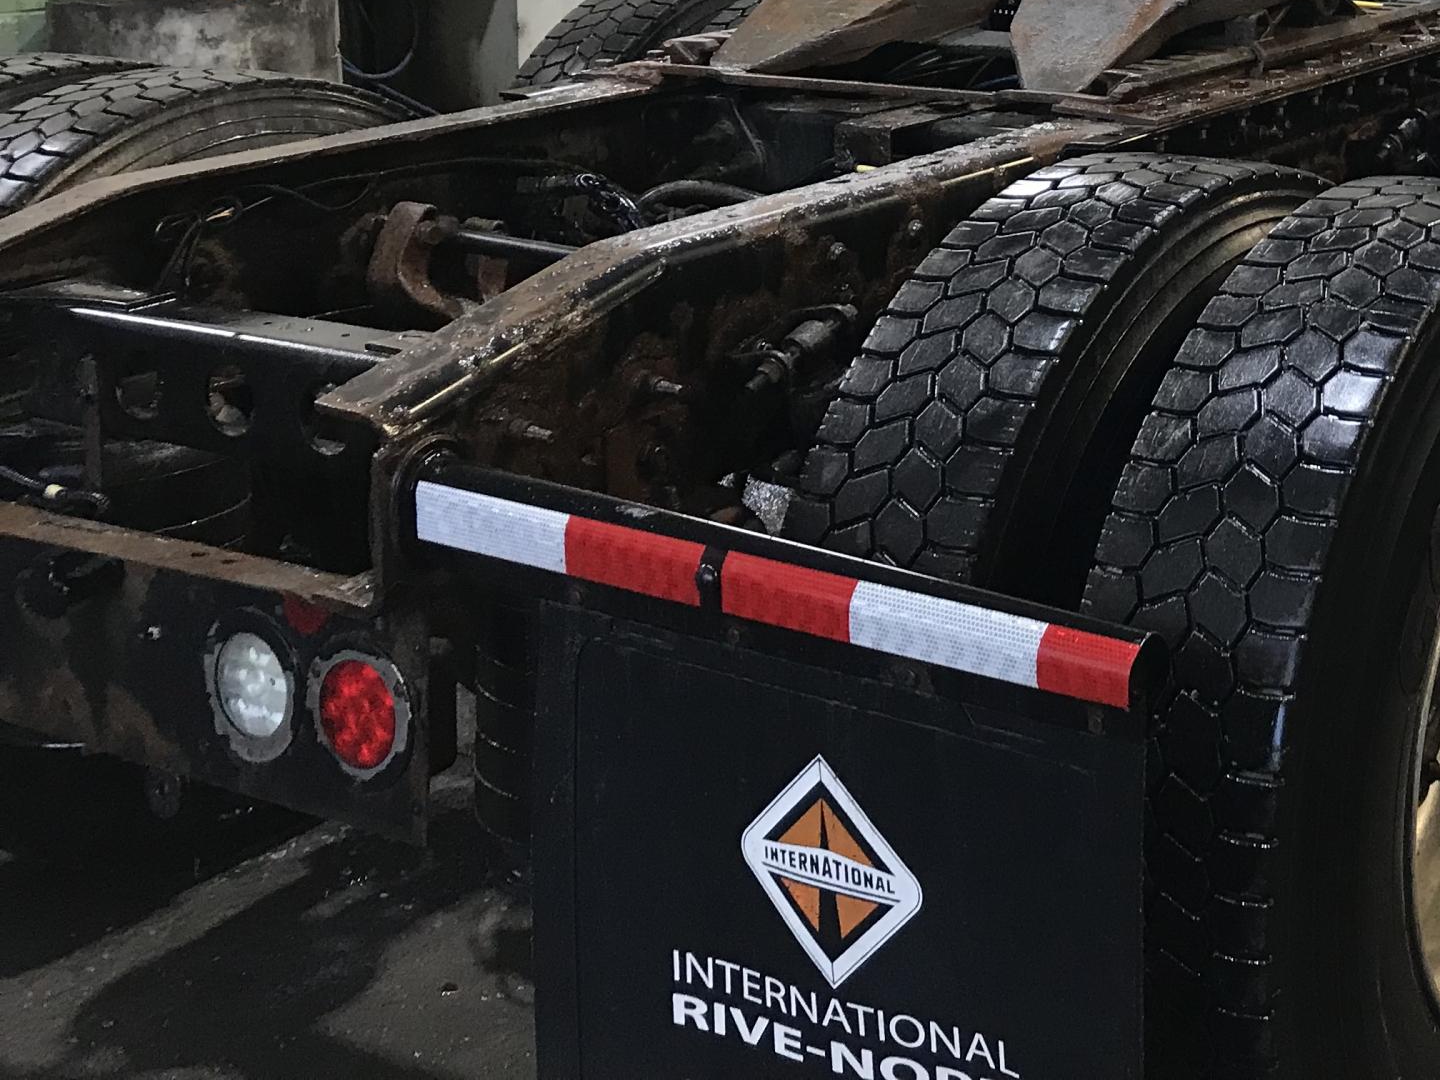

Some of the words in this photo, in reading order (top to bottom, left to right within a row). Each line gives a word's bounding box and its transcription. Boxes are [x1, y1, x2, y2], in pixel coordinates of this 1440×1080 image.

[764, 845, 896, 895] INTERNATIONAL
[672, 949, 1020, 1079] INTERNATIONAL
[672, 993, 1002, 1080] RIVE-NO
